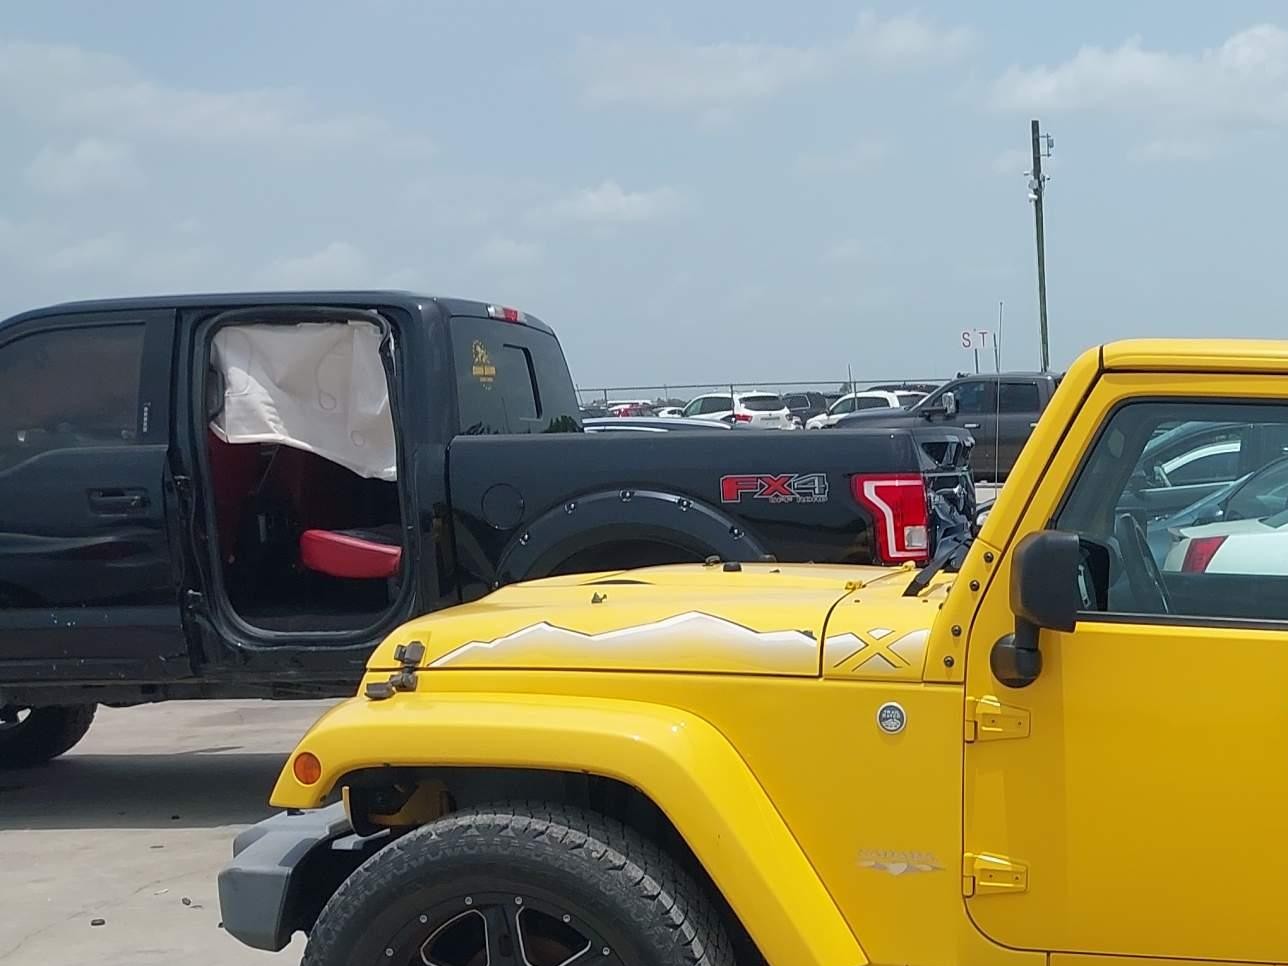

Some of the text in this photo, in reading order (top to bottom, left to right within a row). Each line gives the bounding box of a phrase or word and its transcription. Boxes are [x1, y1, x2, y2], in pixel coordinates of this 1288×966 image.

[962, 331, 988, 348] S T
[720, 473, 829, 503] FX4
